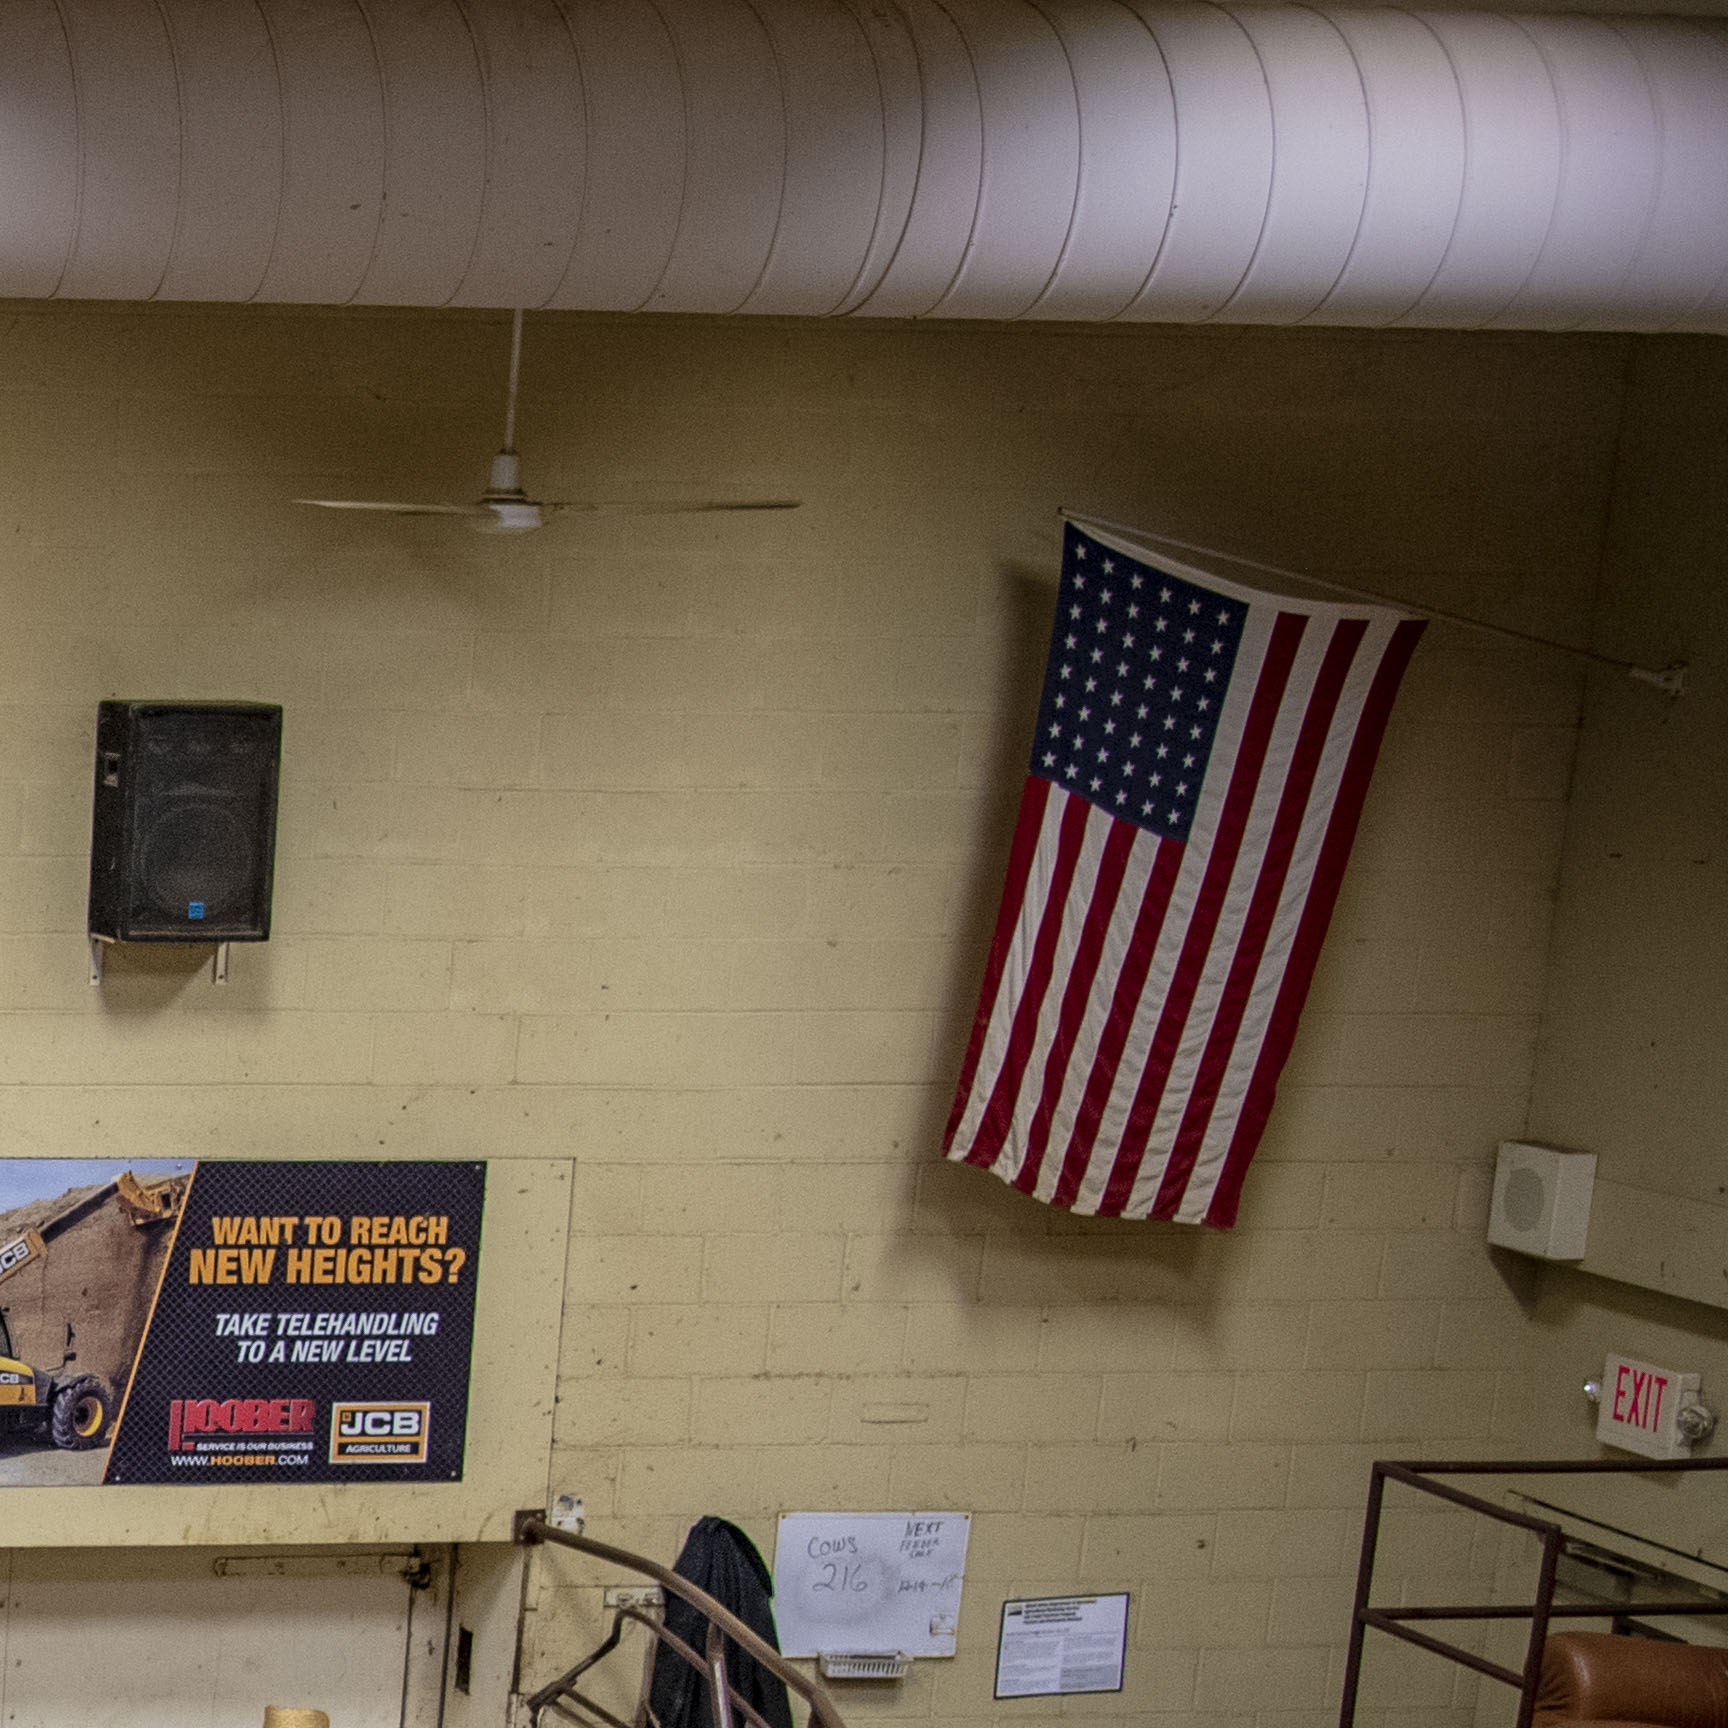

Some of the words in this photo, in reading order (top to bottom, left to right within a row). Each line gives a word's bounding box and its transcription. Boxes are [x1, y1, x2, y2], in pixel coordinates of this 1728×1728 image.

[212, 1216, 299, 1245] WANT
[305, 1216, 341, 1245] TO
[350, 1216, 448, 1245] REACH
[189, 1248, 276, 1284] NEW
[286, 1247, 466, 1284] HEIGHTS?
[215, 1314, 271, 1336] TAKE
[275, 1313, 439, 1336] TELEHANDLING
[237, 1341, 266, 1363] TO
[268, 1341, 286, 1363] A
[291, 1340, 343, 1363] NEW
[346, 1339, 412, 1362] LEVEL
[1612, 1365, 1668, 1433] EXIT
[168, 1399, 315, 1450] HOOBER
[340, 1411, 420, 1436] JCB
[196, 1442, 235, 1451] SERVICE
[236, 1442, 246, 1450] IS
[248, 1442, 266, 1450] OUR
[267, 1441, 314, 1450] BUSINESS
[345, 1444, 411, 1454] AGRICULTURE
[170, 1454, 309, 1467] WWW.HOOBER.COM
[905, 1521, 943, 1537] NEXT
[812, 1563, 868, 1592] 216
